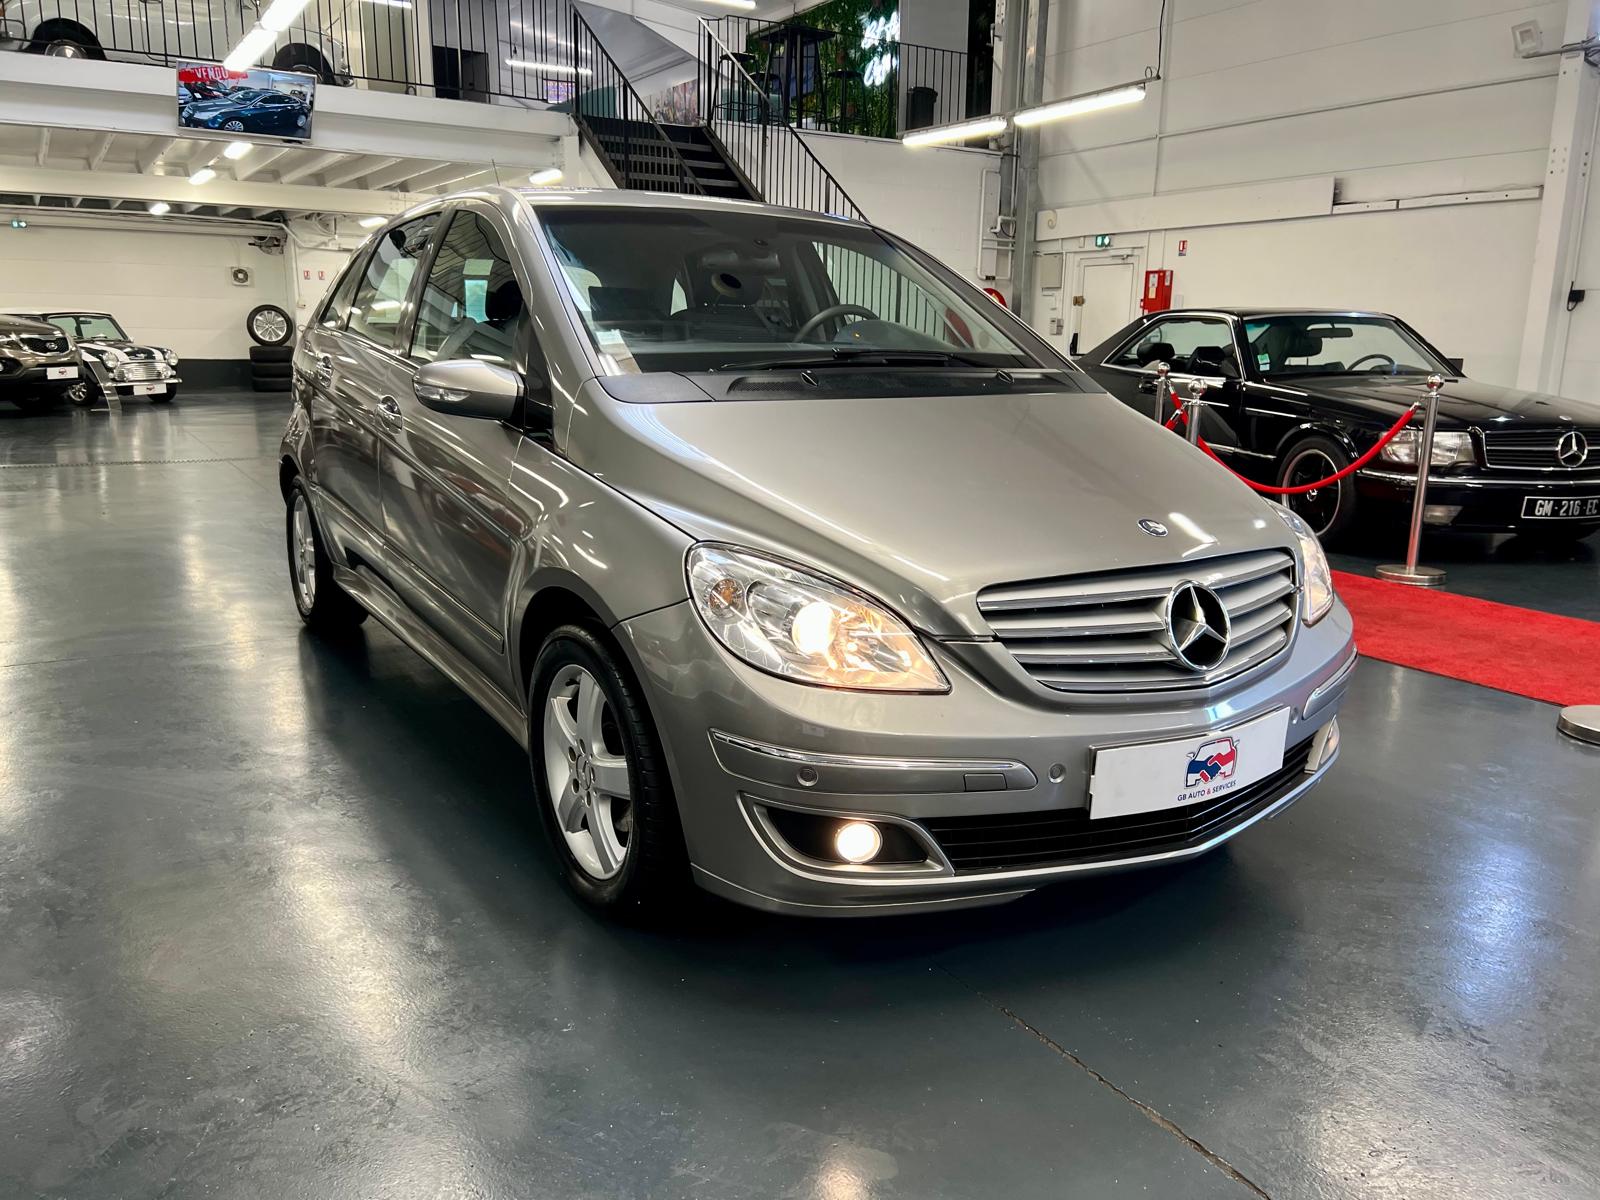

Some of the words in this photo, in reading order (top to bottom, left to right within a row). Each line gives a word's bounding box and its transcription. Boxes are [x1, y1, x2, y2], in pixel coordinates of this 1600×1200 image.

[195, 66, 229, 79] VENDU
[1177, 794, 1187, 802] GB
[1188, 789, 1206, 800] AUTO
[1212, 779, 1237, 794] SERVICES
